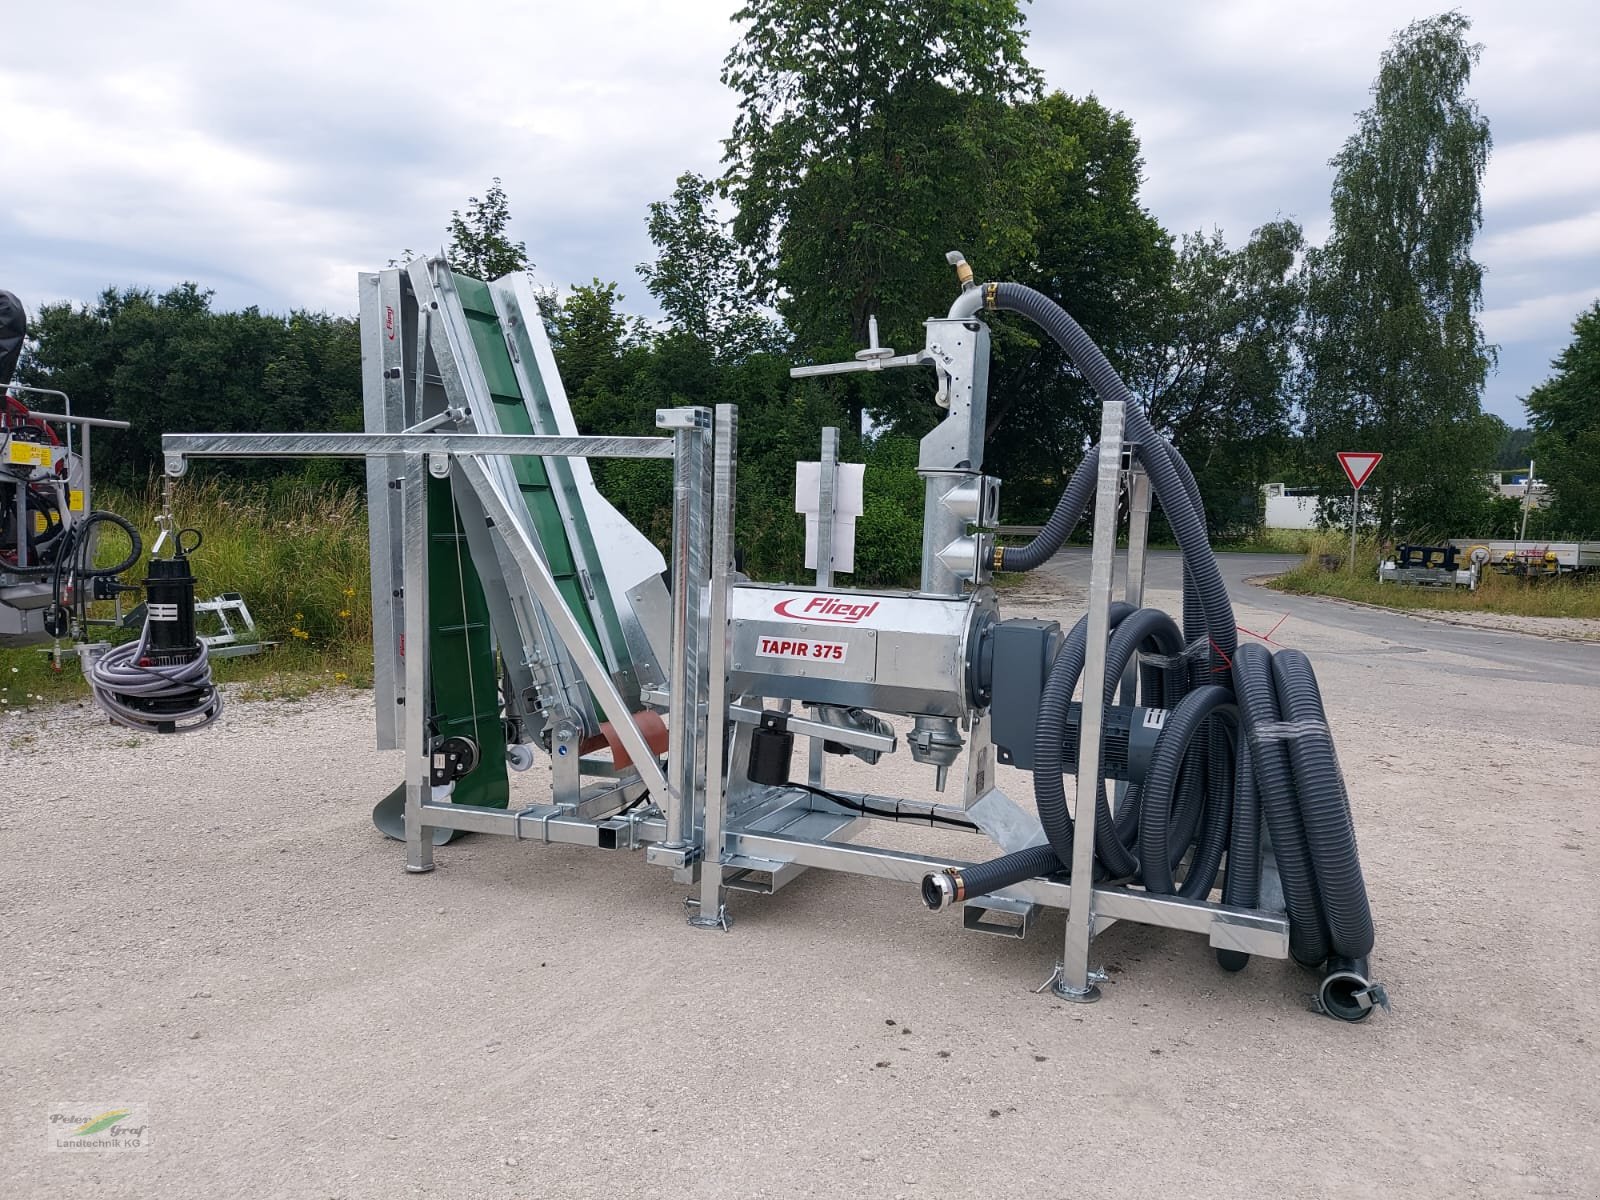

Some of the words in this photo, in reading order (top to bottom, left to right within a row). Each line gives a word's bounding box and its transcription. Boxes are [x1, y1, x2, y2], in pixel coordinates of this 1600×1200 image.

[803, 597, 880, 620] Fliegl
[762, 640, 808, 656] TAPIR
[813, 645, 843, 659] 375
